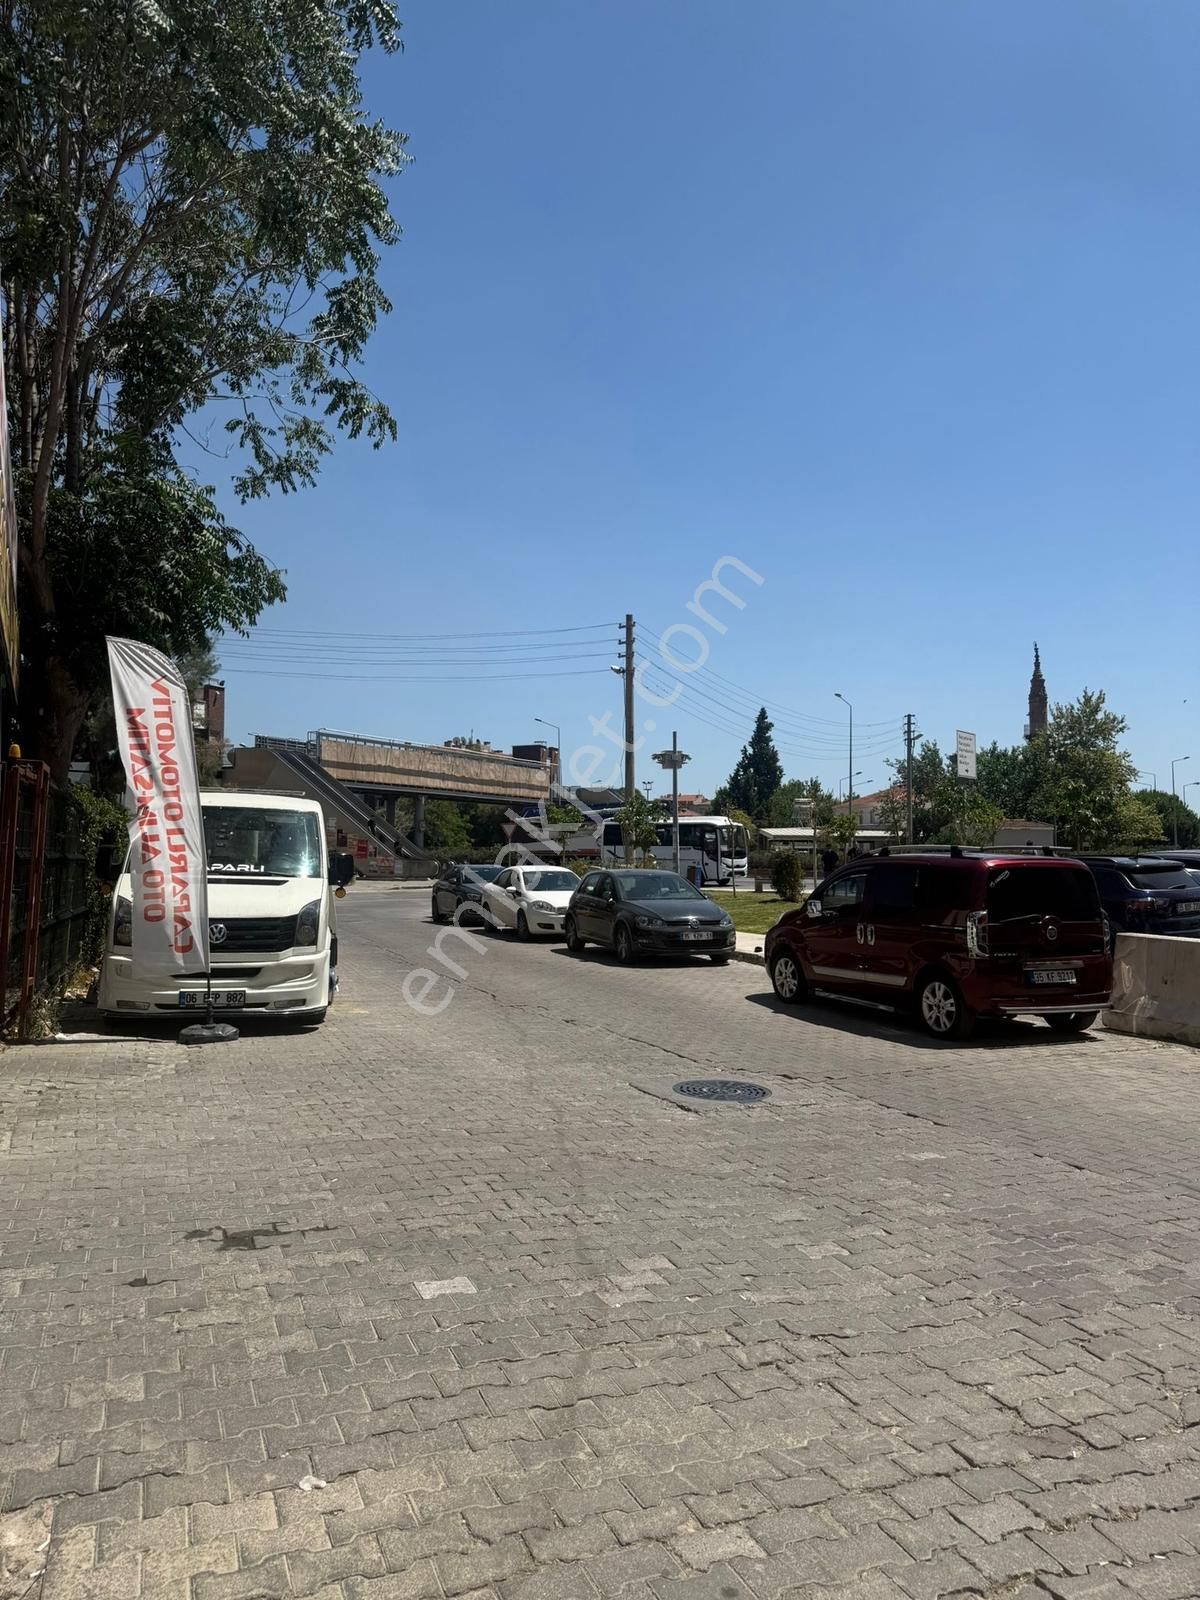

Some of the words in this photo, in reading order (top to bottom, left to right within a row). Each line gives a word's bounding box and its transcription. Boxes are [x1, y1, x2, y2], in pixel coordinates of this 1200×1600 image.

[207, 863, 265, 873] PARLI
[185, 993, 197, 1003] 06
[226, 992, 243, 1003] 882
